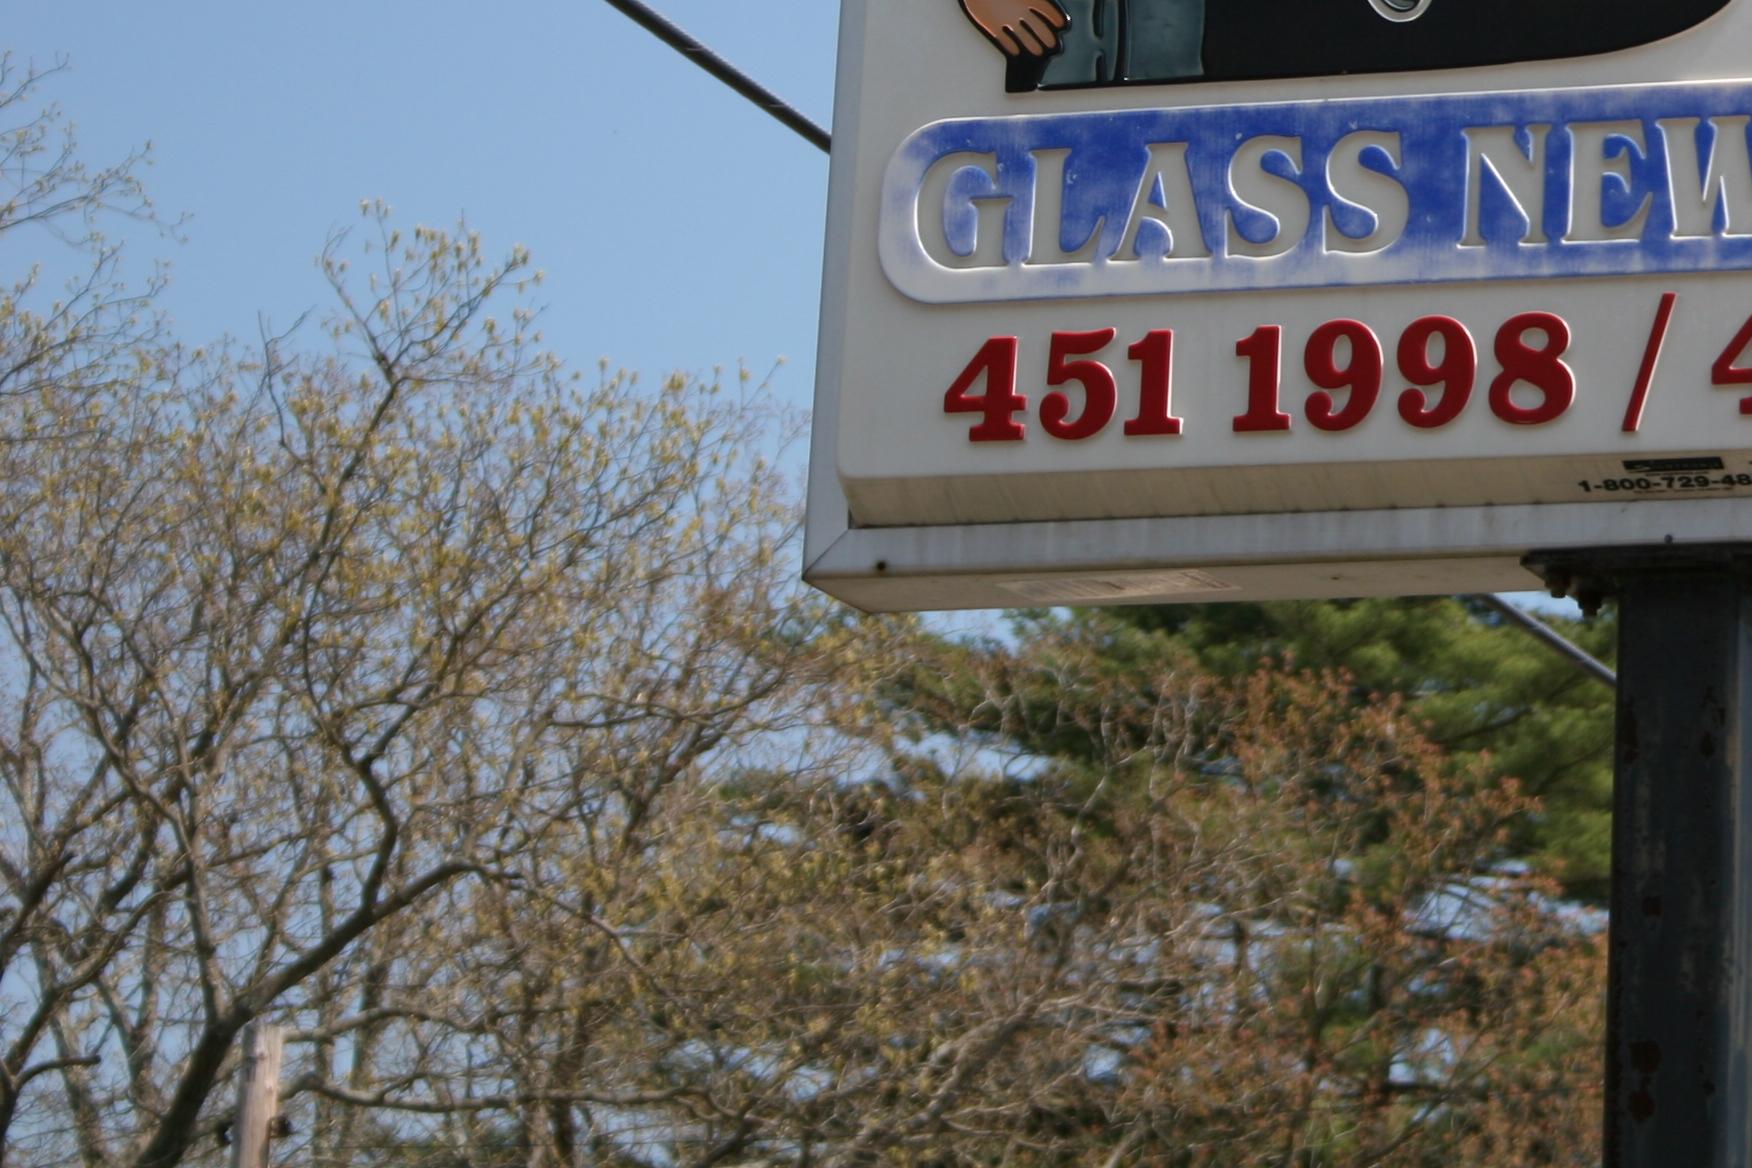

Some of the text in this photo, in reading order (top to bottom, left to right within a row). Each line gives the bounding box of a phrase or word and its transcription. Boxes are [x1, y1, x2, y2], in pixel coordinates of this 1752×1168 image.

[915, 130, 1408, 270] GLASS
[944, 327, 1182, 441] 451
[1232, 311, 1575, 432] 1998
[1621, 292, 1676, 432] /
